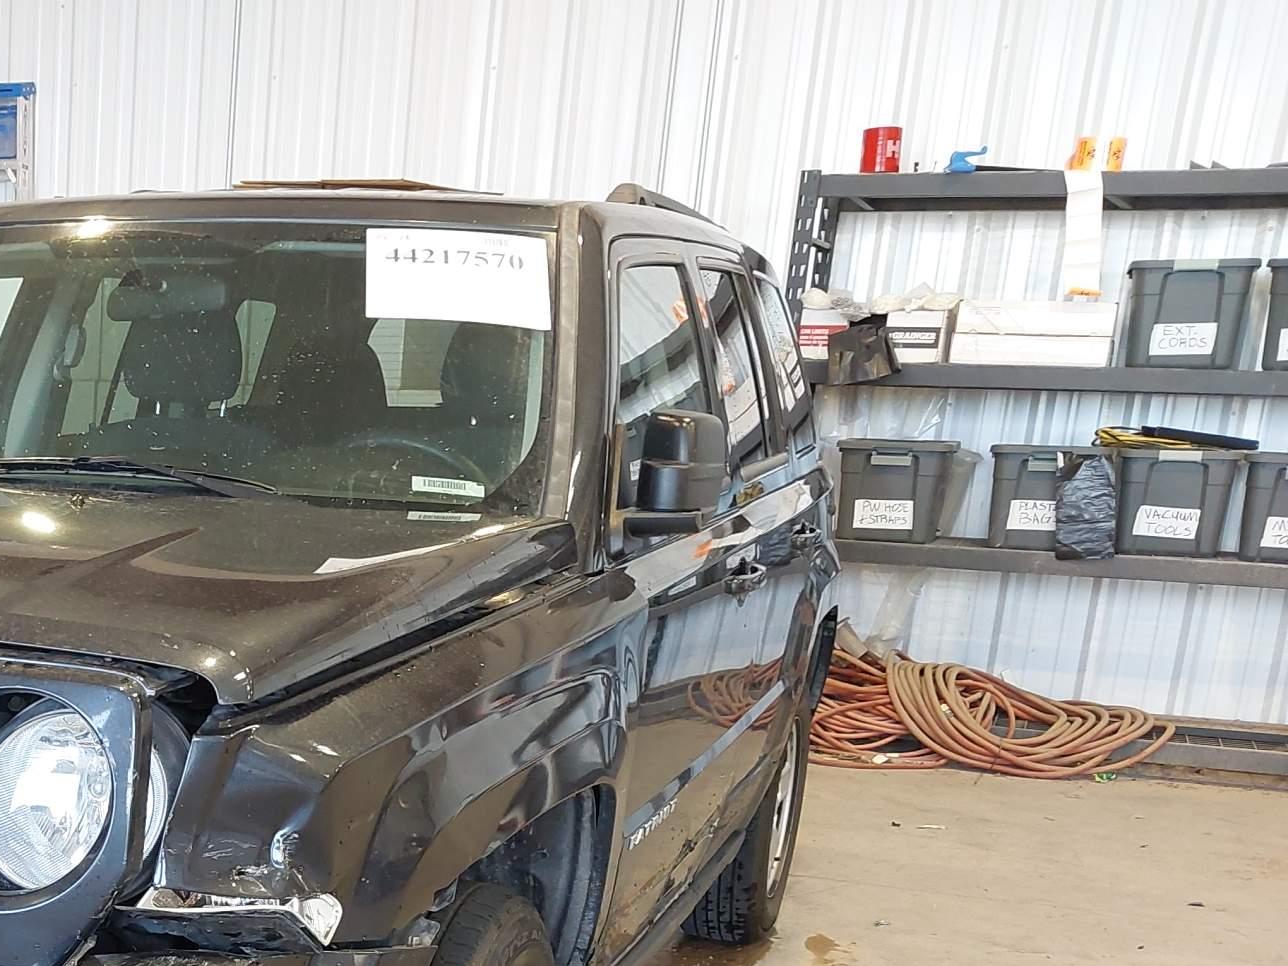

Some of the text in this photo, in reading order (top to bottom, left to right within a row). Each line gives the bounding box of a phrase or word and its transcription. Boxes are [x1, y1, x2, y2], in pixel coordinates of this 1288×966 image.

[385, 247, 524, 271] 44217570
[893, 332, 936, 340] GRAINGER
[1163, 325, 1198, 336] EXT.
[1144, 508, 1199, 522] VACUUM
[1145, 521, 1192, 537] TOOLS
